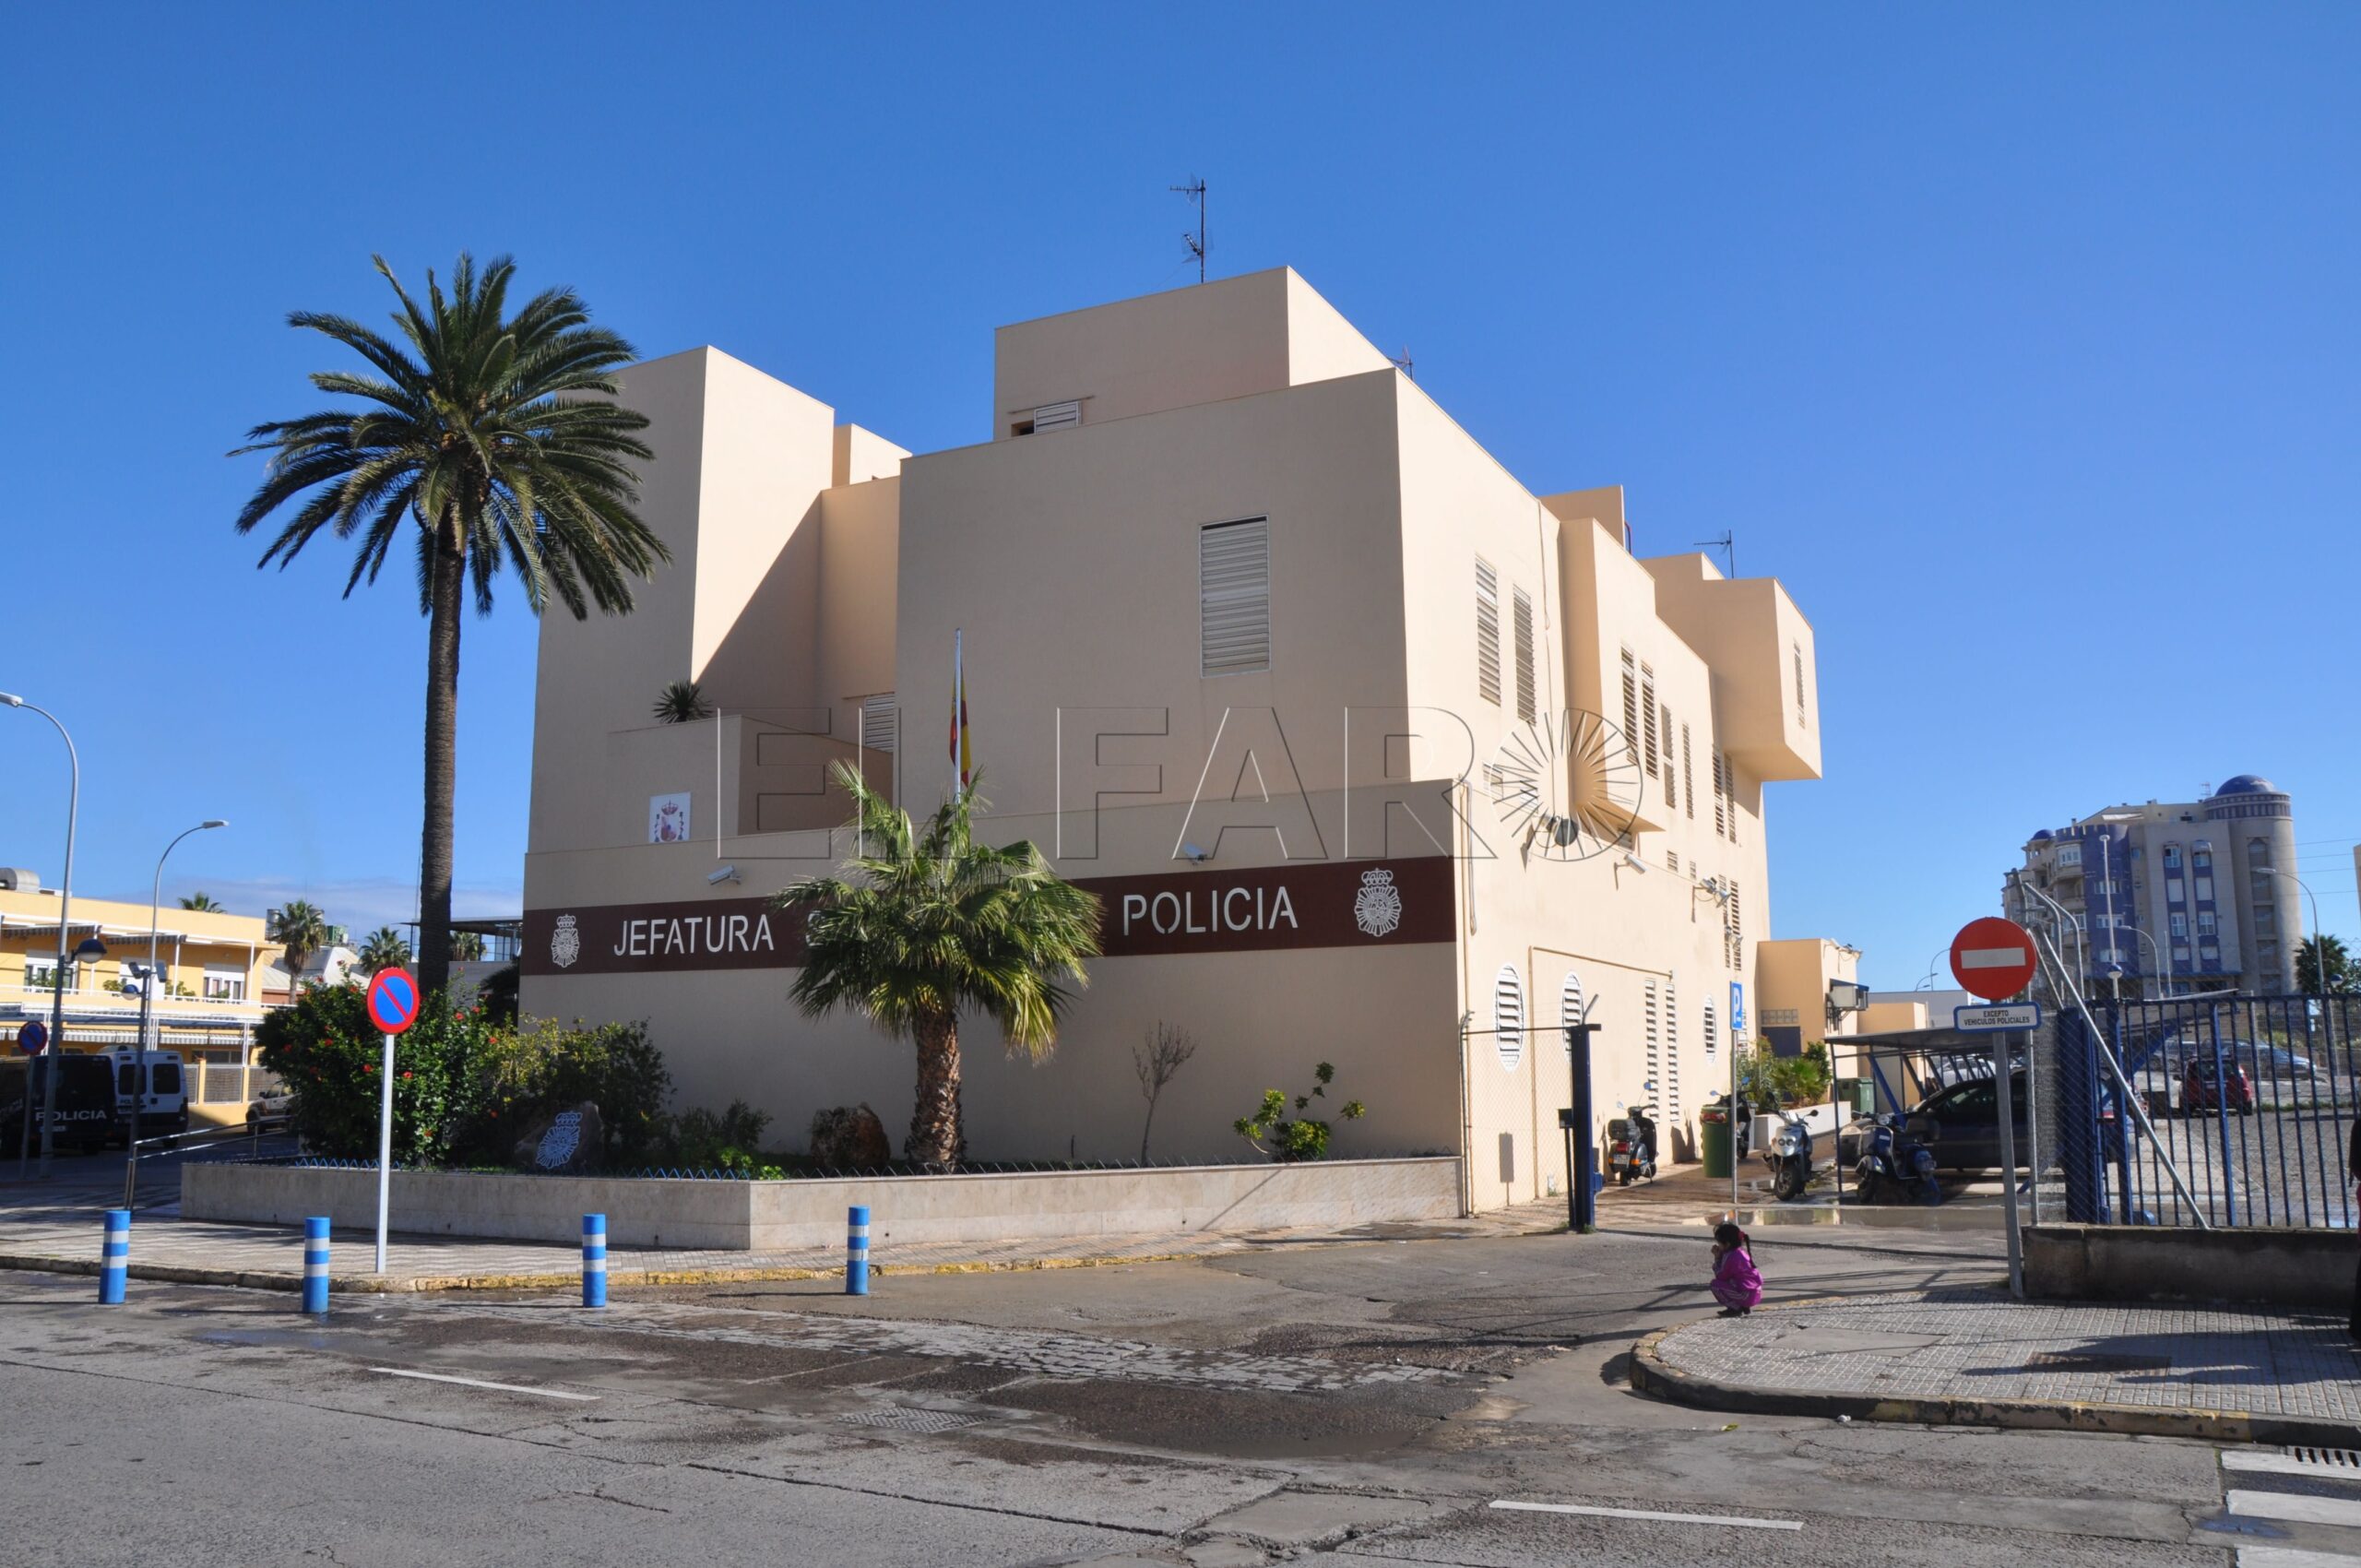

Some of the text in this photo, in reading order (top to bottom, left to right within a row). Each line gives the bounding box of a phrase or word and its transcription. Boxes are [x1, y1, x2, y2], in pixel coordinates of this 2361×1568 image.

[613, 914, 775, 956] JEFATURA
[1123, 885, 1299, 936] POLICIA
[1997, 1016, 2030, 1025] POLICIALES
